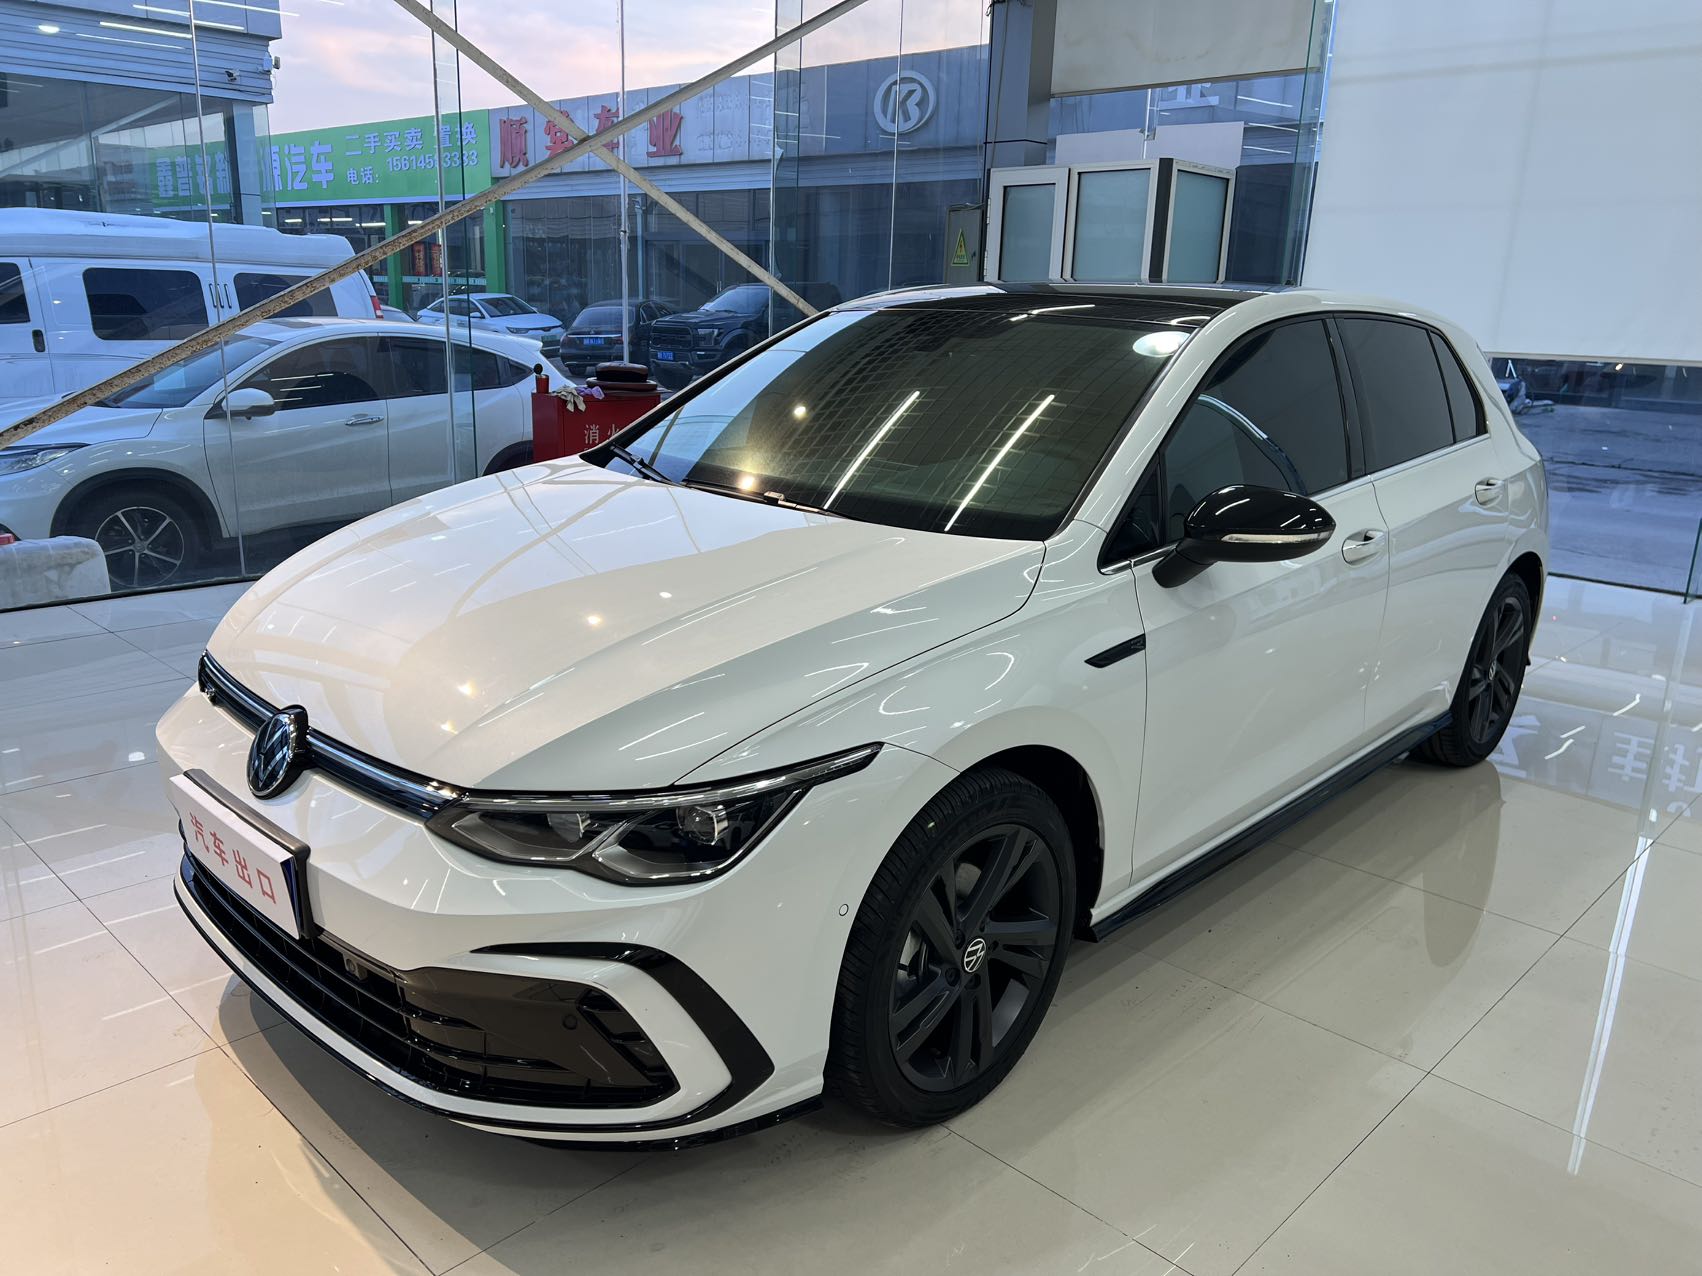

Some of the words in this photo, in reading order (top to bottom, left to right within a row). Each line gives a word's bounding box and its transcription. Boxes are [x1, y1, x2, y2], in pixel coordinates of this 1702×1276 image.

[345, 127, 423, 156] 二手买卖
[386, 149, 478, 172] 1561453333
[189, 811, 277, 904] 汽车出口
